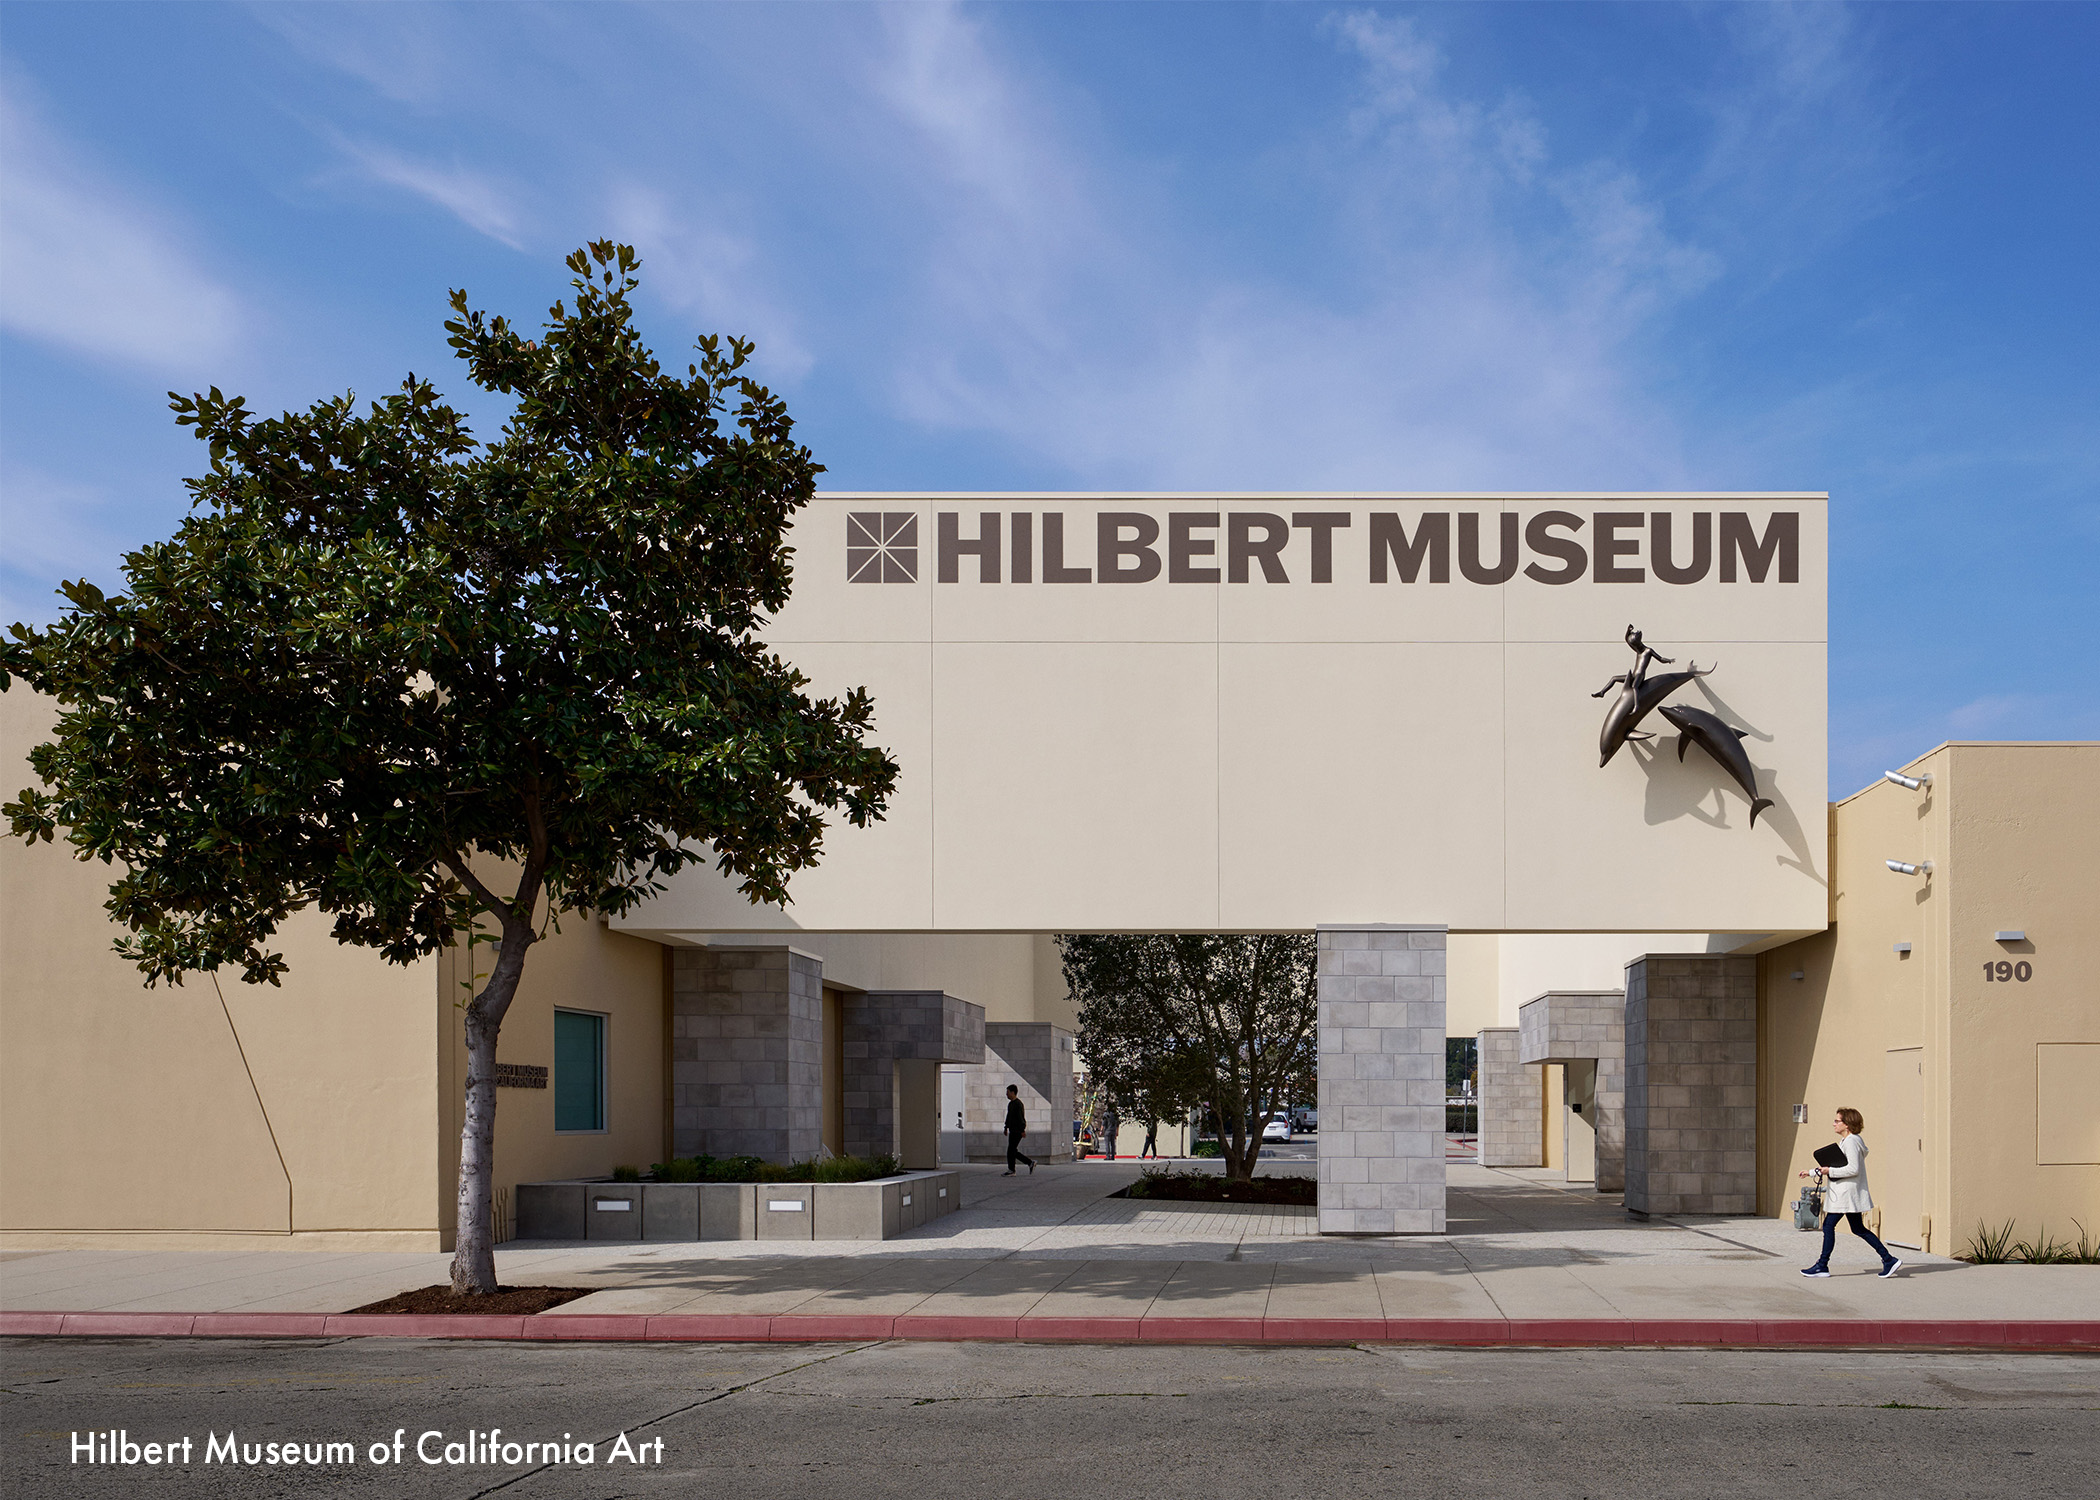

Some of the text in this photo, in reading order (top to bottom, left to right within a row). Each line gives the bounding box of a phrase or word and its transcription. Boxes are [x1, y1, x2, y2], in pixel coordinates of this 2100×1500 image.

[938, 511, 1800, 585] HILBERT MUSEUM
[1983, 961, 2032, 982] 190
[518, 1065, 549, 1078] MUSEUM
